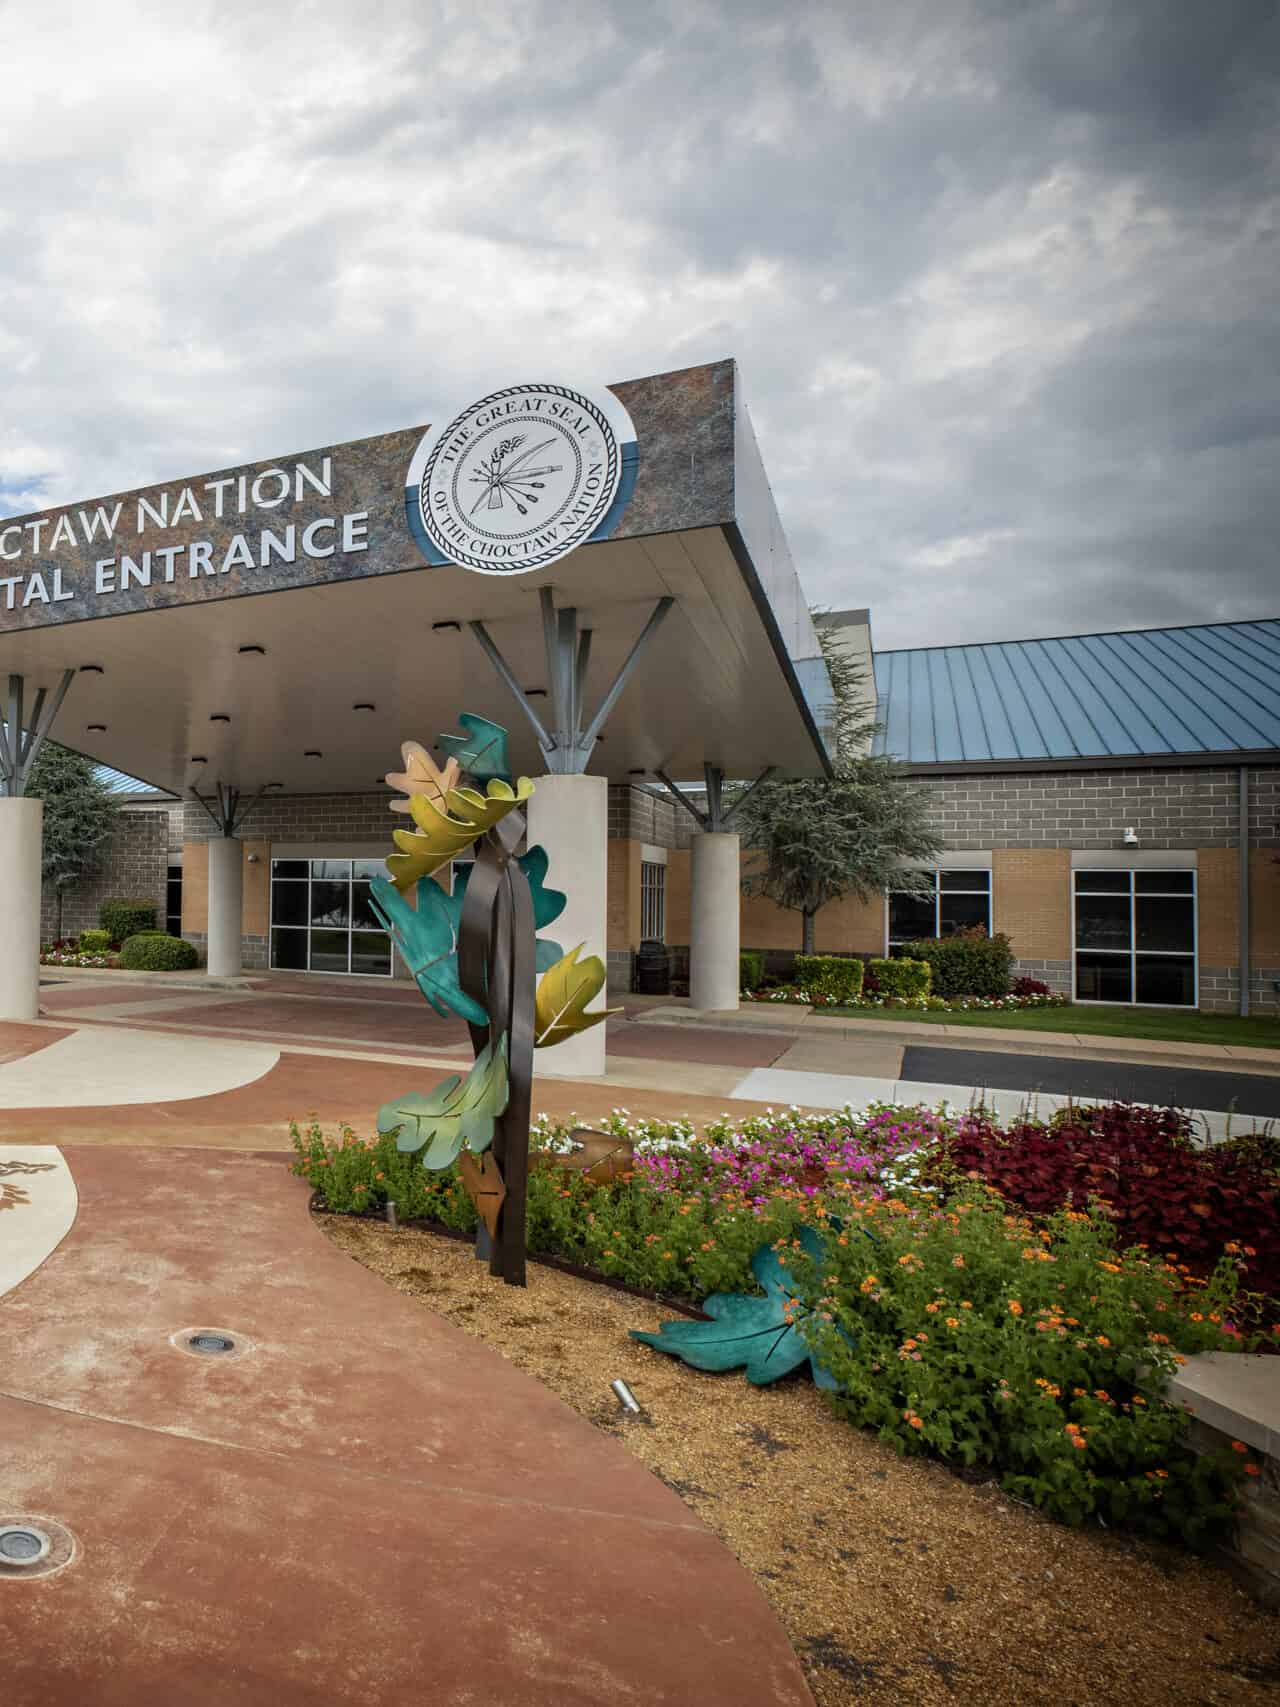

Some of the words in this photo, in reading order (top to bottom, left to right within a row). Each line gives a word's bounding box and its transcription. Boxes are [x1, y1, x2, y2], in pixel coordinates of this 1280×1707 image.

[441, 426, 474, 464] THE
[476, 398, 547, 428] GREAT
[548, 402, 590, 439] SEAL
[137, 457, 332, 534] NATION
[434, 490, 449, 512] OF
[560, 463, 603, 531] NATION
[95, 511, 369, 595] ENTRANCE
[440, 512, 470, 546] THE
[470, 528, 559, 557] CHOCTAW
